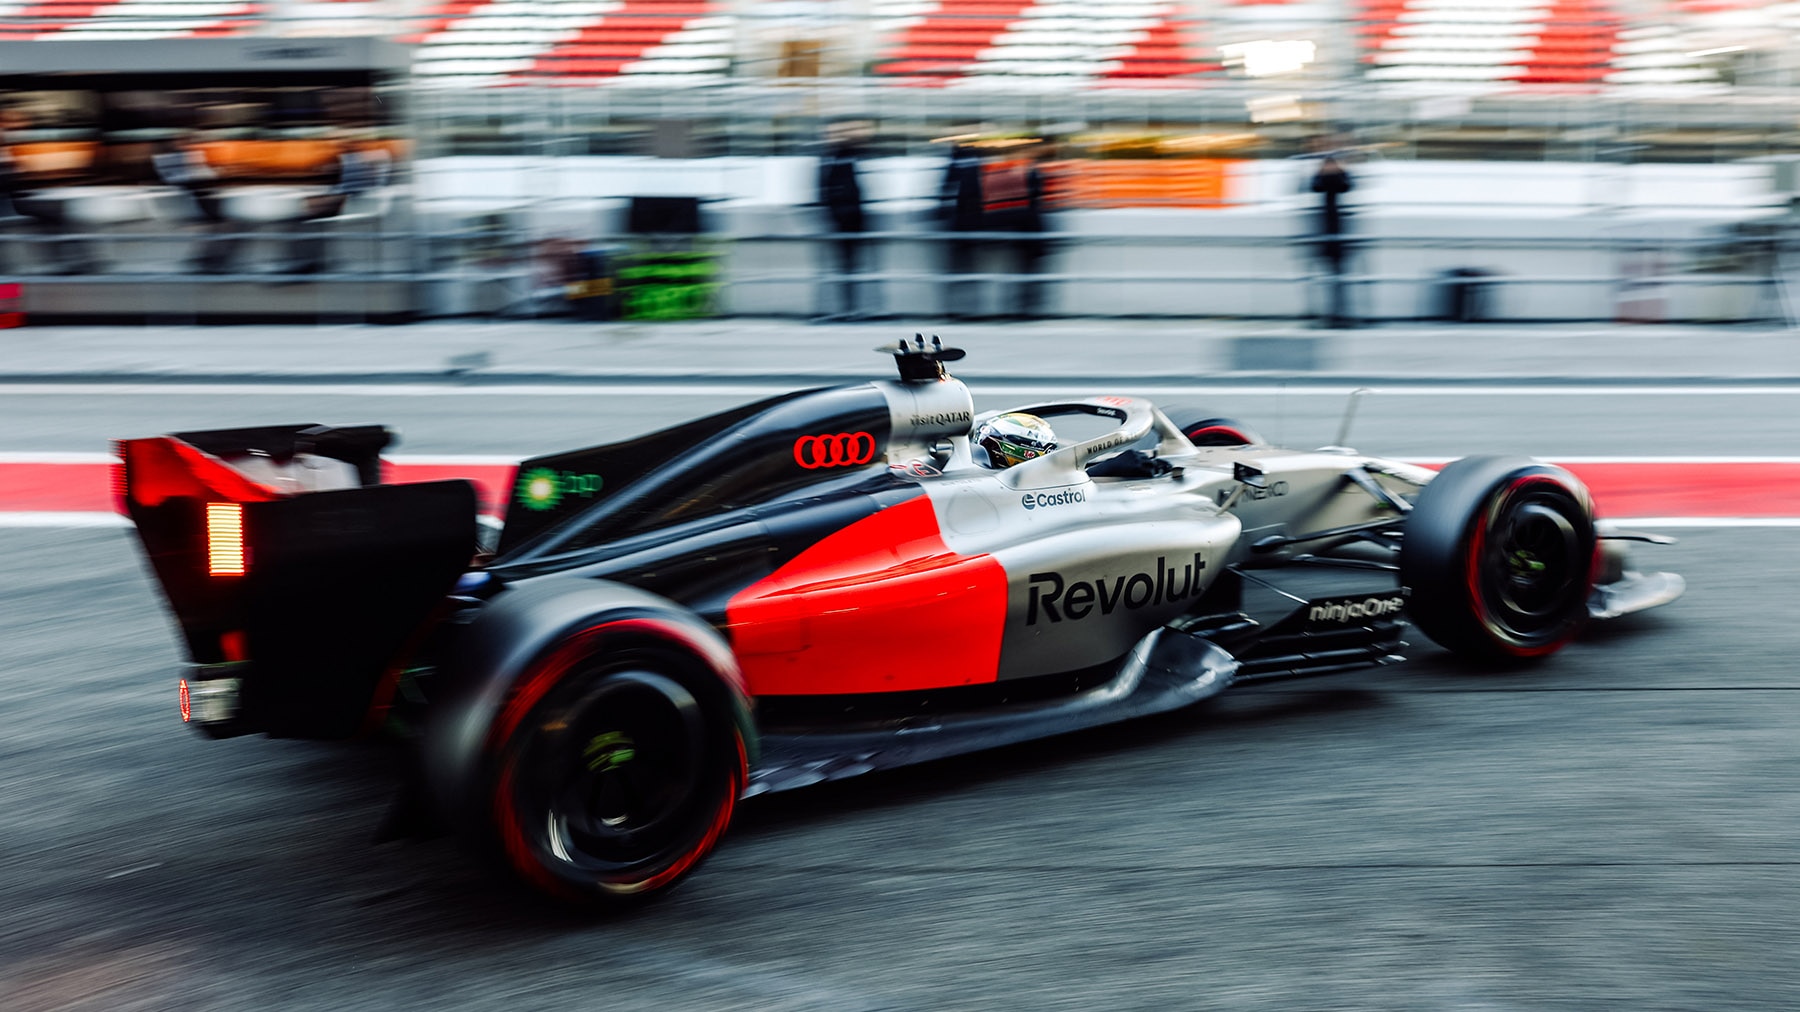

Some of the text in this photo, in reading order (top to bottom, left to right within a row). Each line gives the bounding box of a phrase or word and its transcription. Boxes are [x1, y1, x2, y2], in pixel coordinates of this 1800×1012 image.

[1087, 440, 1112, 454] WORLD
[1037, 488, 1086, 507] Castrol
[1026, 552, 1206, 626] Revolut
[1309, 597, 1404, 623] ninjaOne
